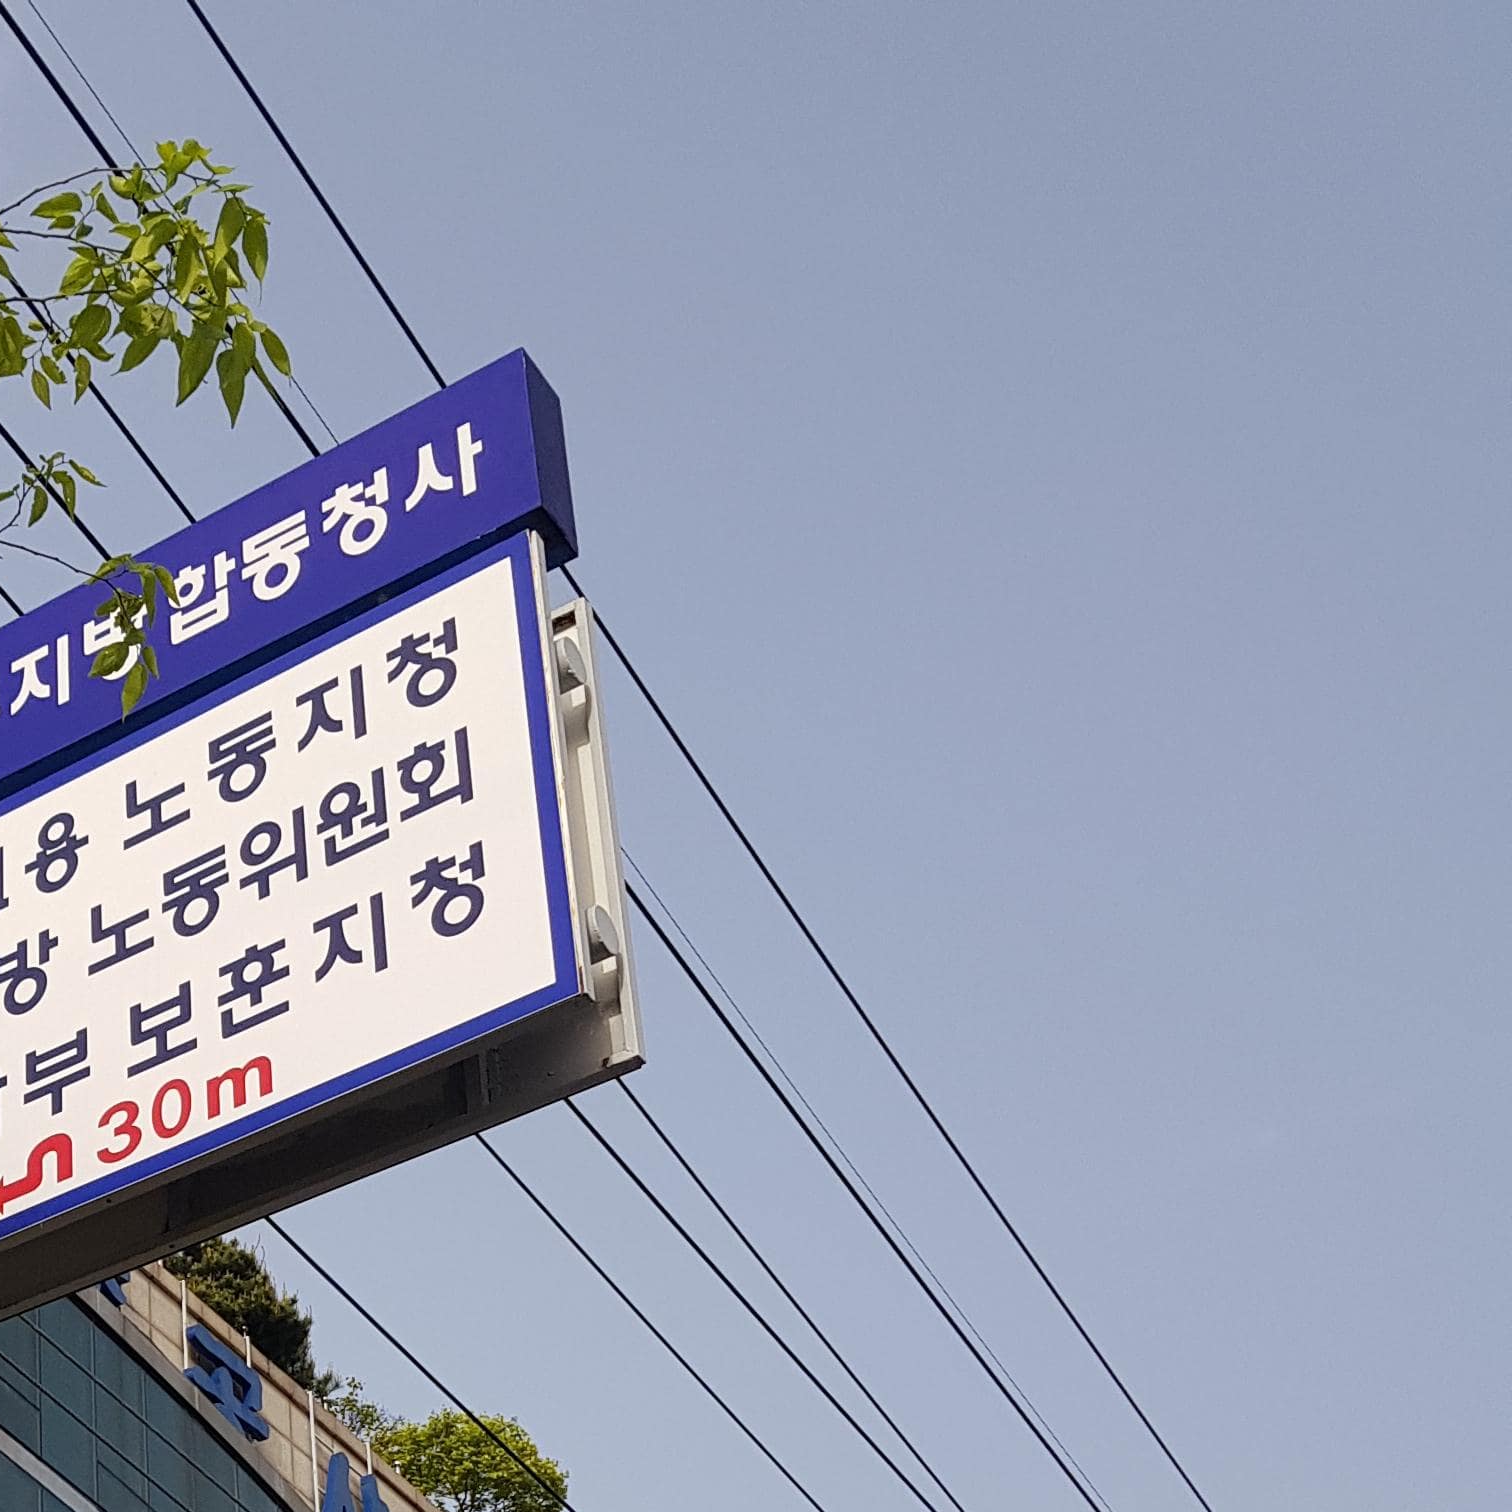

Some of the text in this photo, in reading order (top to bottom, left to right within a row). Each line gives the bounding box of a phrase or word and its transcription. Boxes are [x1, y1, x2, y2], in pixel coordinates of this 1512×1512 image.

[89, 728, 472, 977] 노동위원회
[128, 842, 485, 1076] 보훈지청
[97, 1055, 273, 1164] 30m
